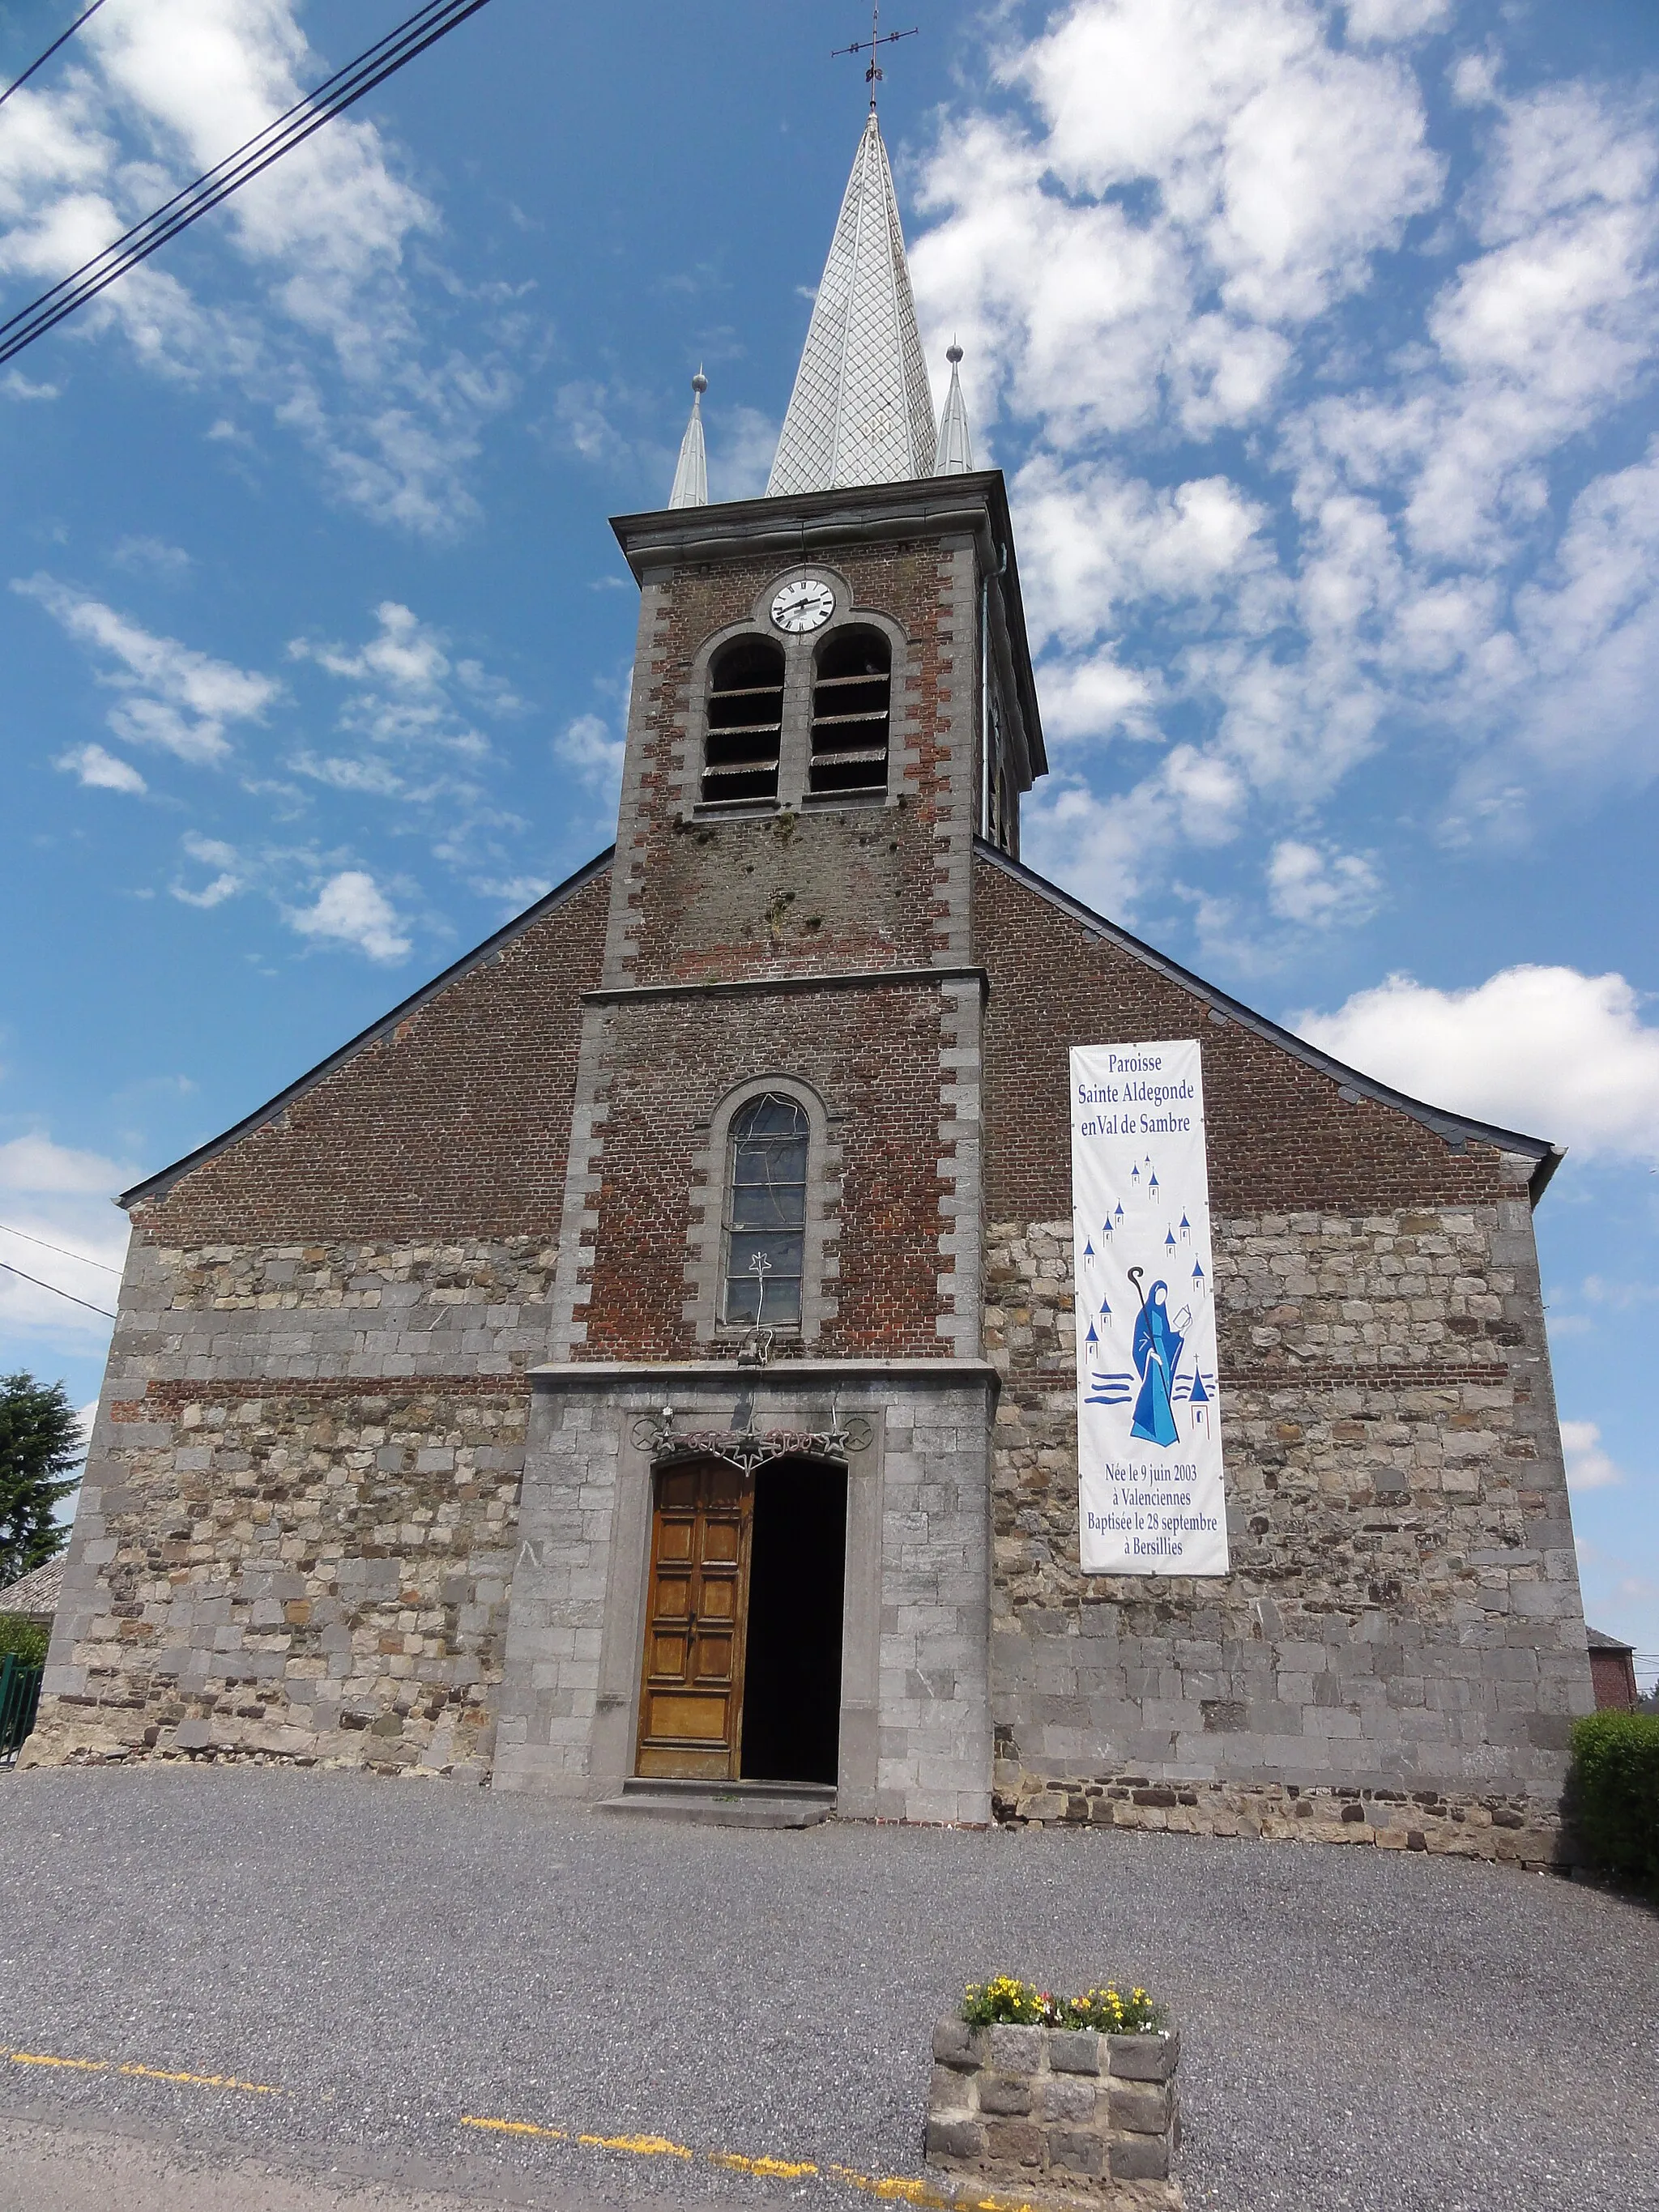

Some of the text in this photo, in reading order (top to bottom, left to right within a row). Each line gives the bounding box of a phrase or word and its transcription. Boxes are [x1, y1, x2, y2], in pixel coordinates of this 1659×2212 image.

[1108, 1053, 1162, 1072] Paroisse
[1078, 1080, 1194, 1106] Sainte Aldegonde
[1121, 1115, 1136, 1133] de
[1141, 1112, 1190, 1133] Sambre
[1105, 1464, 1196, 1486] Née le 9 juin 2003
[1113, 1487, 1191, 1506] à Valenciennes
[1088, 1511, 1217, 1536] Baptisée le 28 septembre
[1124, 1536, 1183, 1554] à Bersillies
